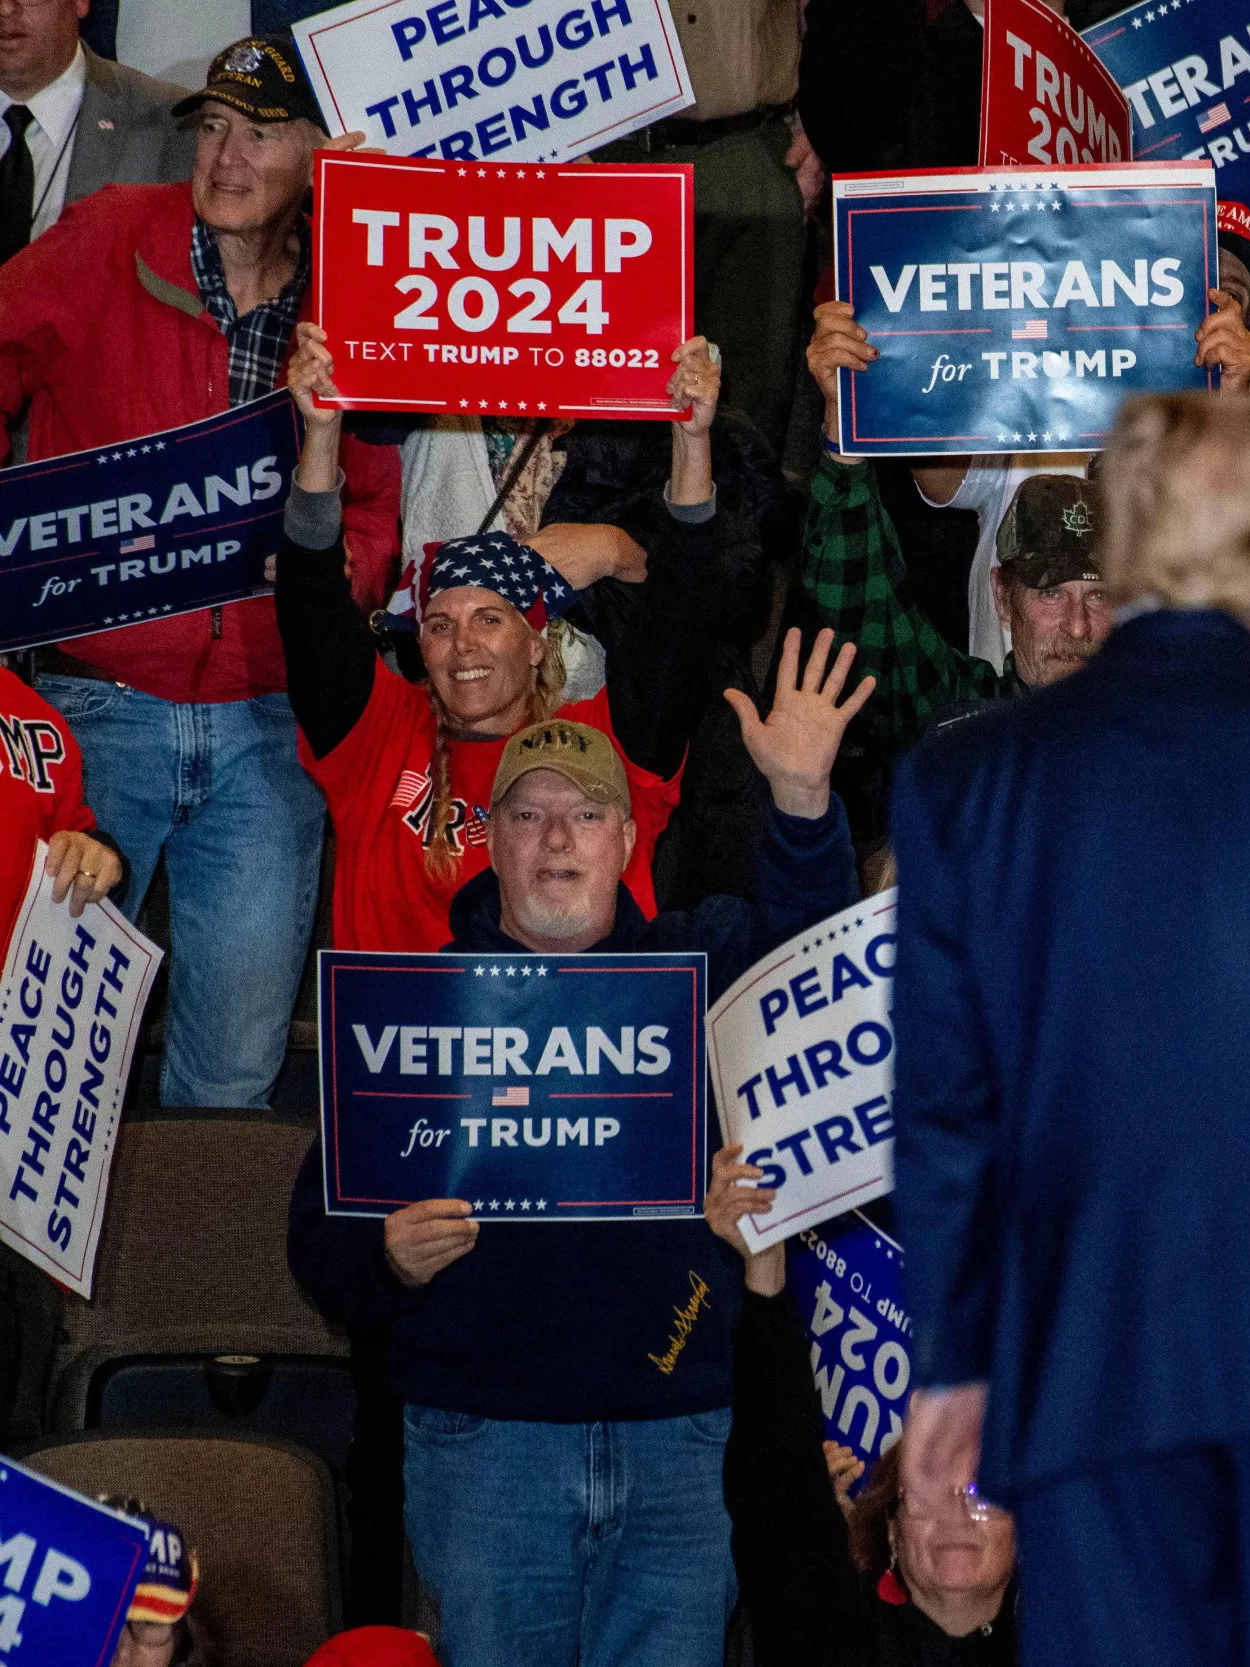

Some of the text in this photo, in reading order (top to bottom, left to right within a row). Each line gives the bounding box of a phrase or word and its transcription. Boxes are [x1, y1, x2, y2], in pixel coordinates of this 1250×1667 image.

[391, 0, 536, 63] PEA
[365, 0, 633, 140] THROUGH
[407, 43, 658, 162] RENGTH
[352, 208, 653, 273] TRUMP
[393, 274, 610, 335] 2024
[870, 258, 1184, 313] VETERANS
[345, 341, 659, 369] TEXT TRUMP TO 88022
[922, 349, 1137, 393] for TRUMP
[0, 455, 283, 557] VETERANS
[32, 540, 242, 607] for TRUMP
[759, 933, 898, 1036] PEAC
[10, 924, 96, 1204] THROUGH
[352, 1024, 671, 1076] VETERANS
[737, 1021, 893, 1121] THRO
[47, 944, 131, 1252] STRENGTH
[400, 1117, 621, 1158] for TRUMP
[746, 1095, 897, 1190] STRE
[850, 1272, 872, 1304] TO
[811, 1280, 910, 1400] 024
